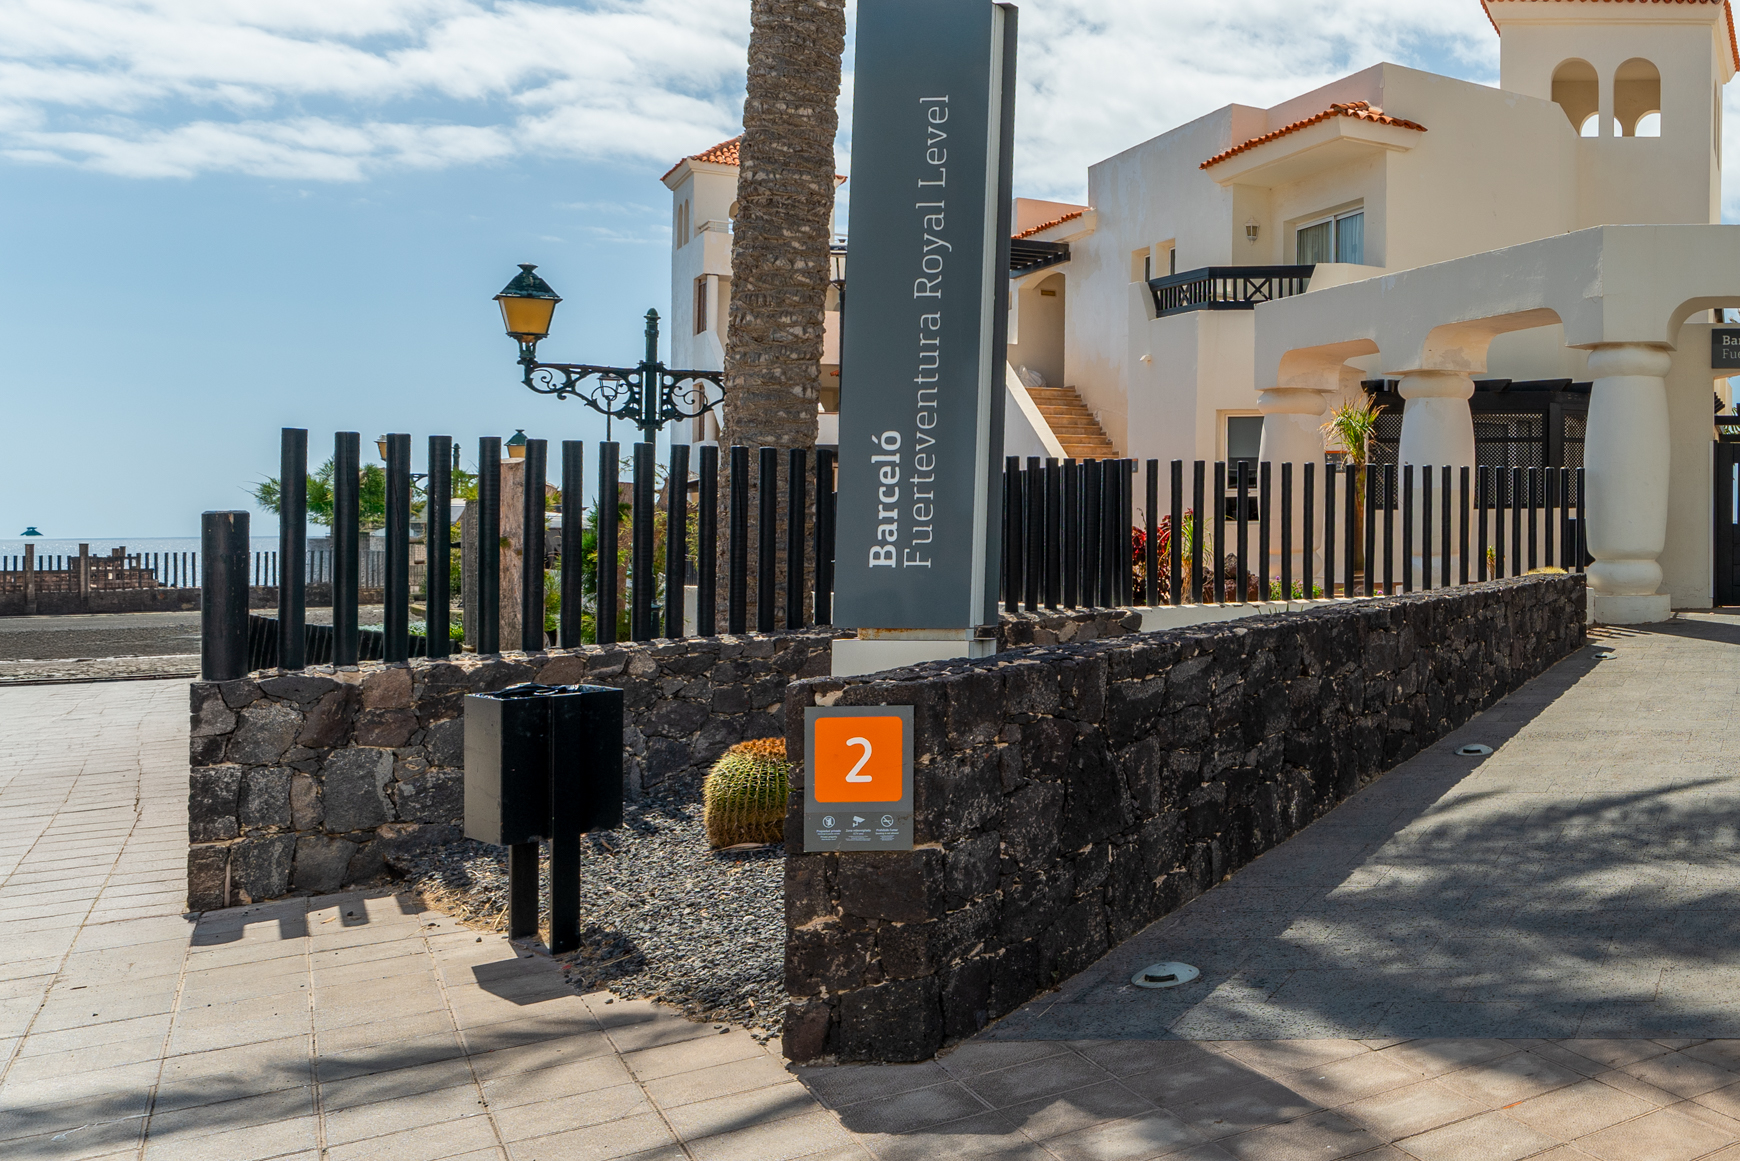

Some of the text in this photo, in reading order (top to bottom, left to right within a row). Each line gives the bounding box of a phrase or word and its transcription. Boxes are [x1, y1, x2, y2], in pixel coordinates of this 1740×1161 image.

[903, 94, 952, 568] Fuerteventura Royal Level
[868, 430, 901, 568] Barceló
[845, 736, 873, 783] 2
